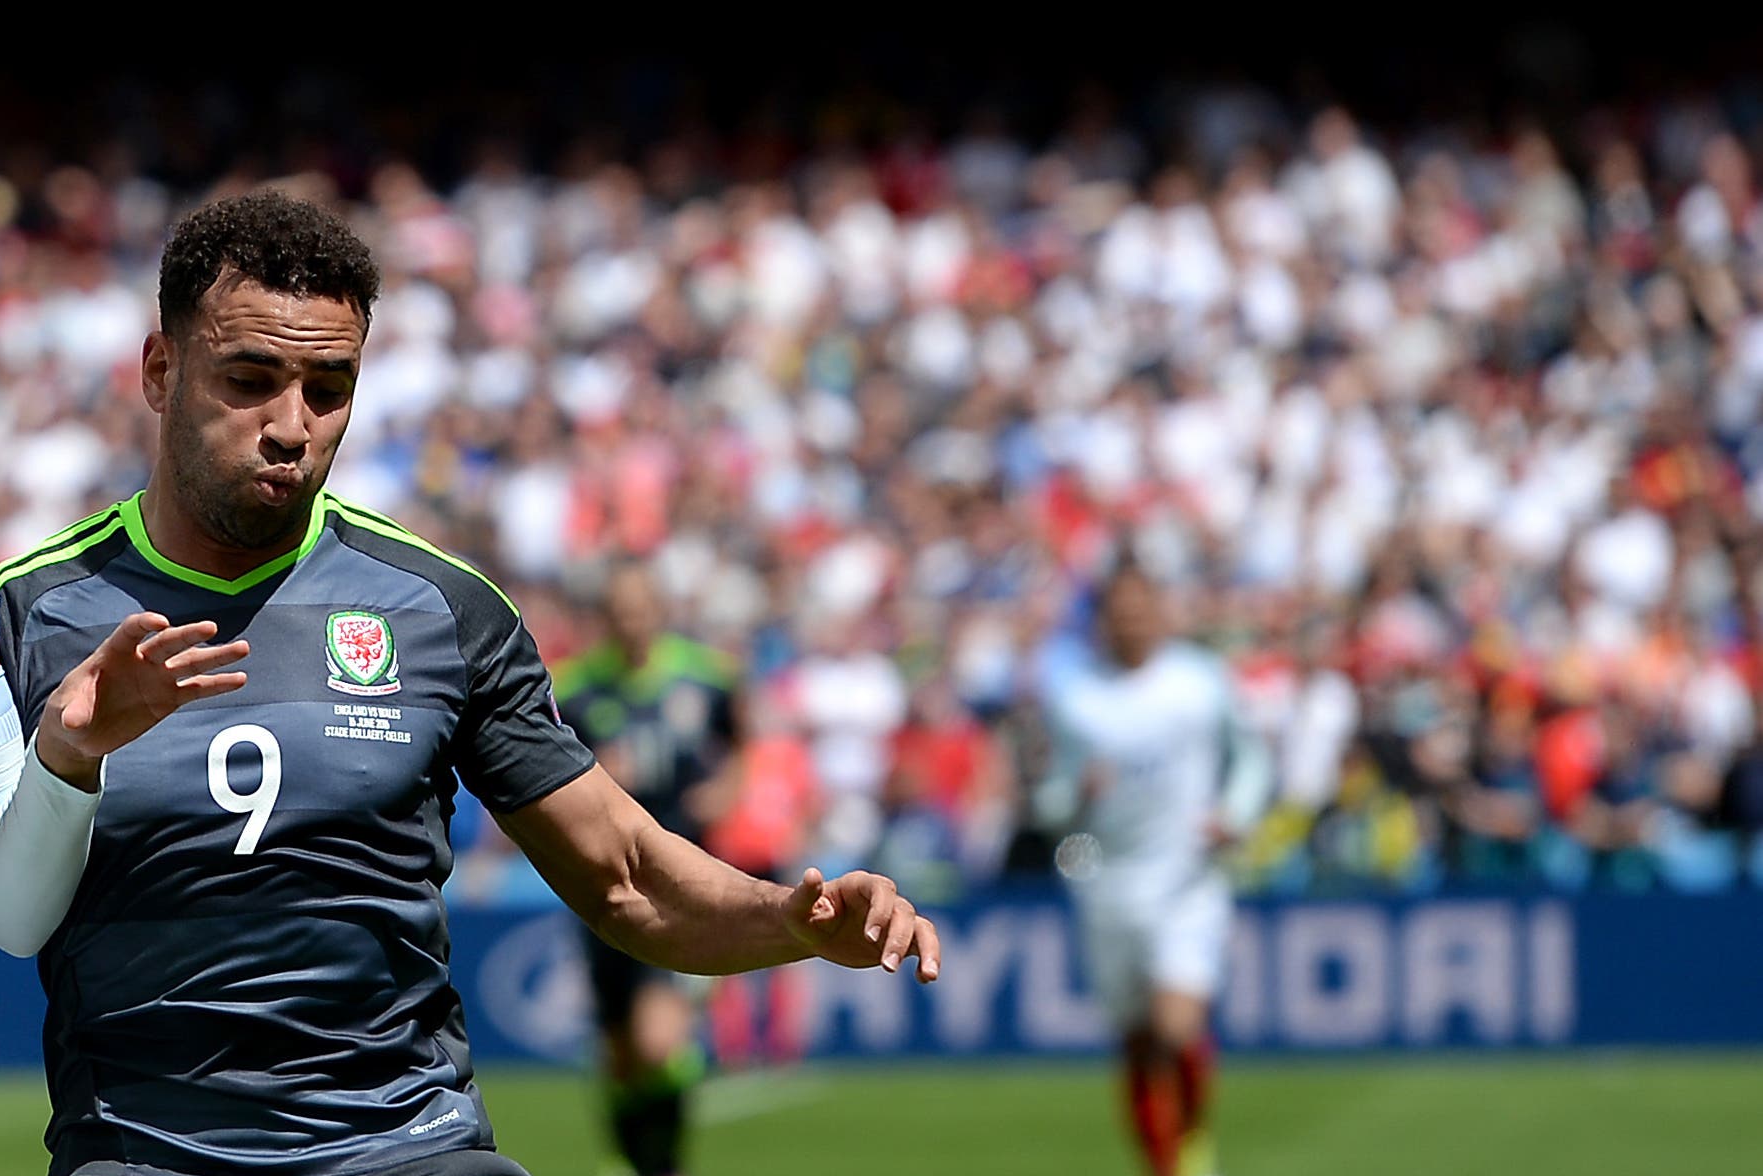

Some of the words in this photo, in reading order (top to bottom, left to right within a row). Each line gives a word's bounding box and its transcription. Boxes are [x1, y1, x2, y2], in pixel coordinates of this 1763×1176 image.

[334, 704, 367, 717] ENGLAND
[378, 707, 402, 720] WALES
[324, 726, 348, 737] STADE
[207, 724, 283, 856] 9
